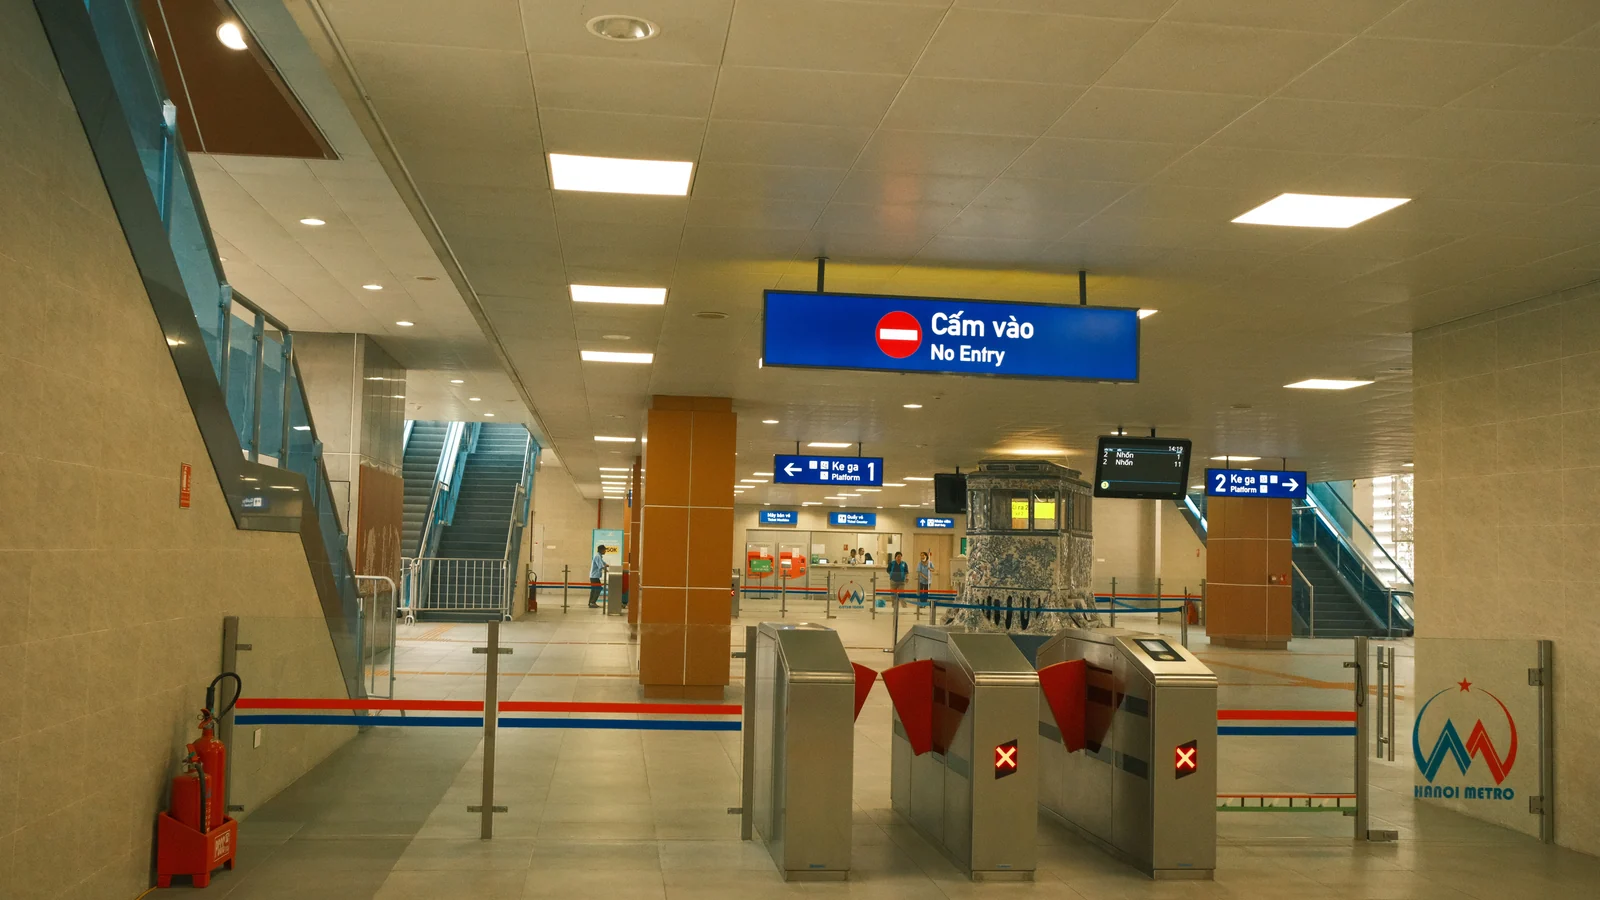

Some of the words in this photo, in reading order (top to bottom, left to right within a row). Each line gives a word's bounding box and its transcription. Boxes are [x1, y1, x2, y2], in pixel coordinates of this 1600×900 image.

[931, 310, 985, 337] Cấm
[992, 315, 1034, 339] vào
[930, 344, 955, 361] No
[960, 344, 1005, 367] Entry
[832, 461, 845, 471] Ke
[847, 464, 859, 473] ga
[868, 462, 875, 481] 1
[1215, 474, 1226, 492] 2
[1230, 474, 1242, 484] Ke
[1244, 476, 1255, 486] ga
[1414, 785, 1460, 798] HANOI
[1464, 787, 1514, 800] METRO
